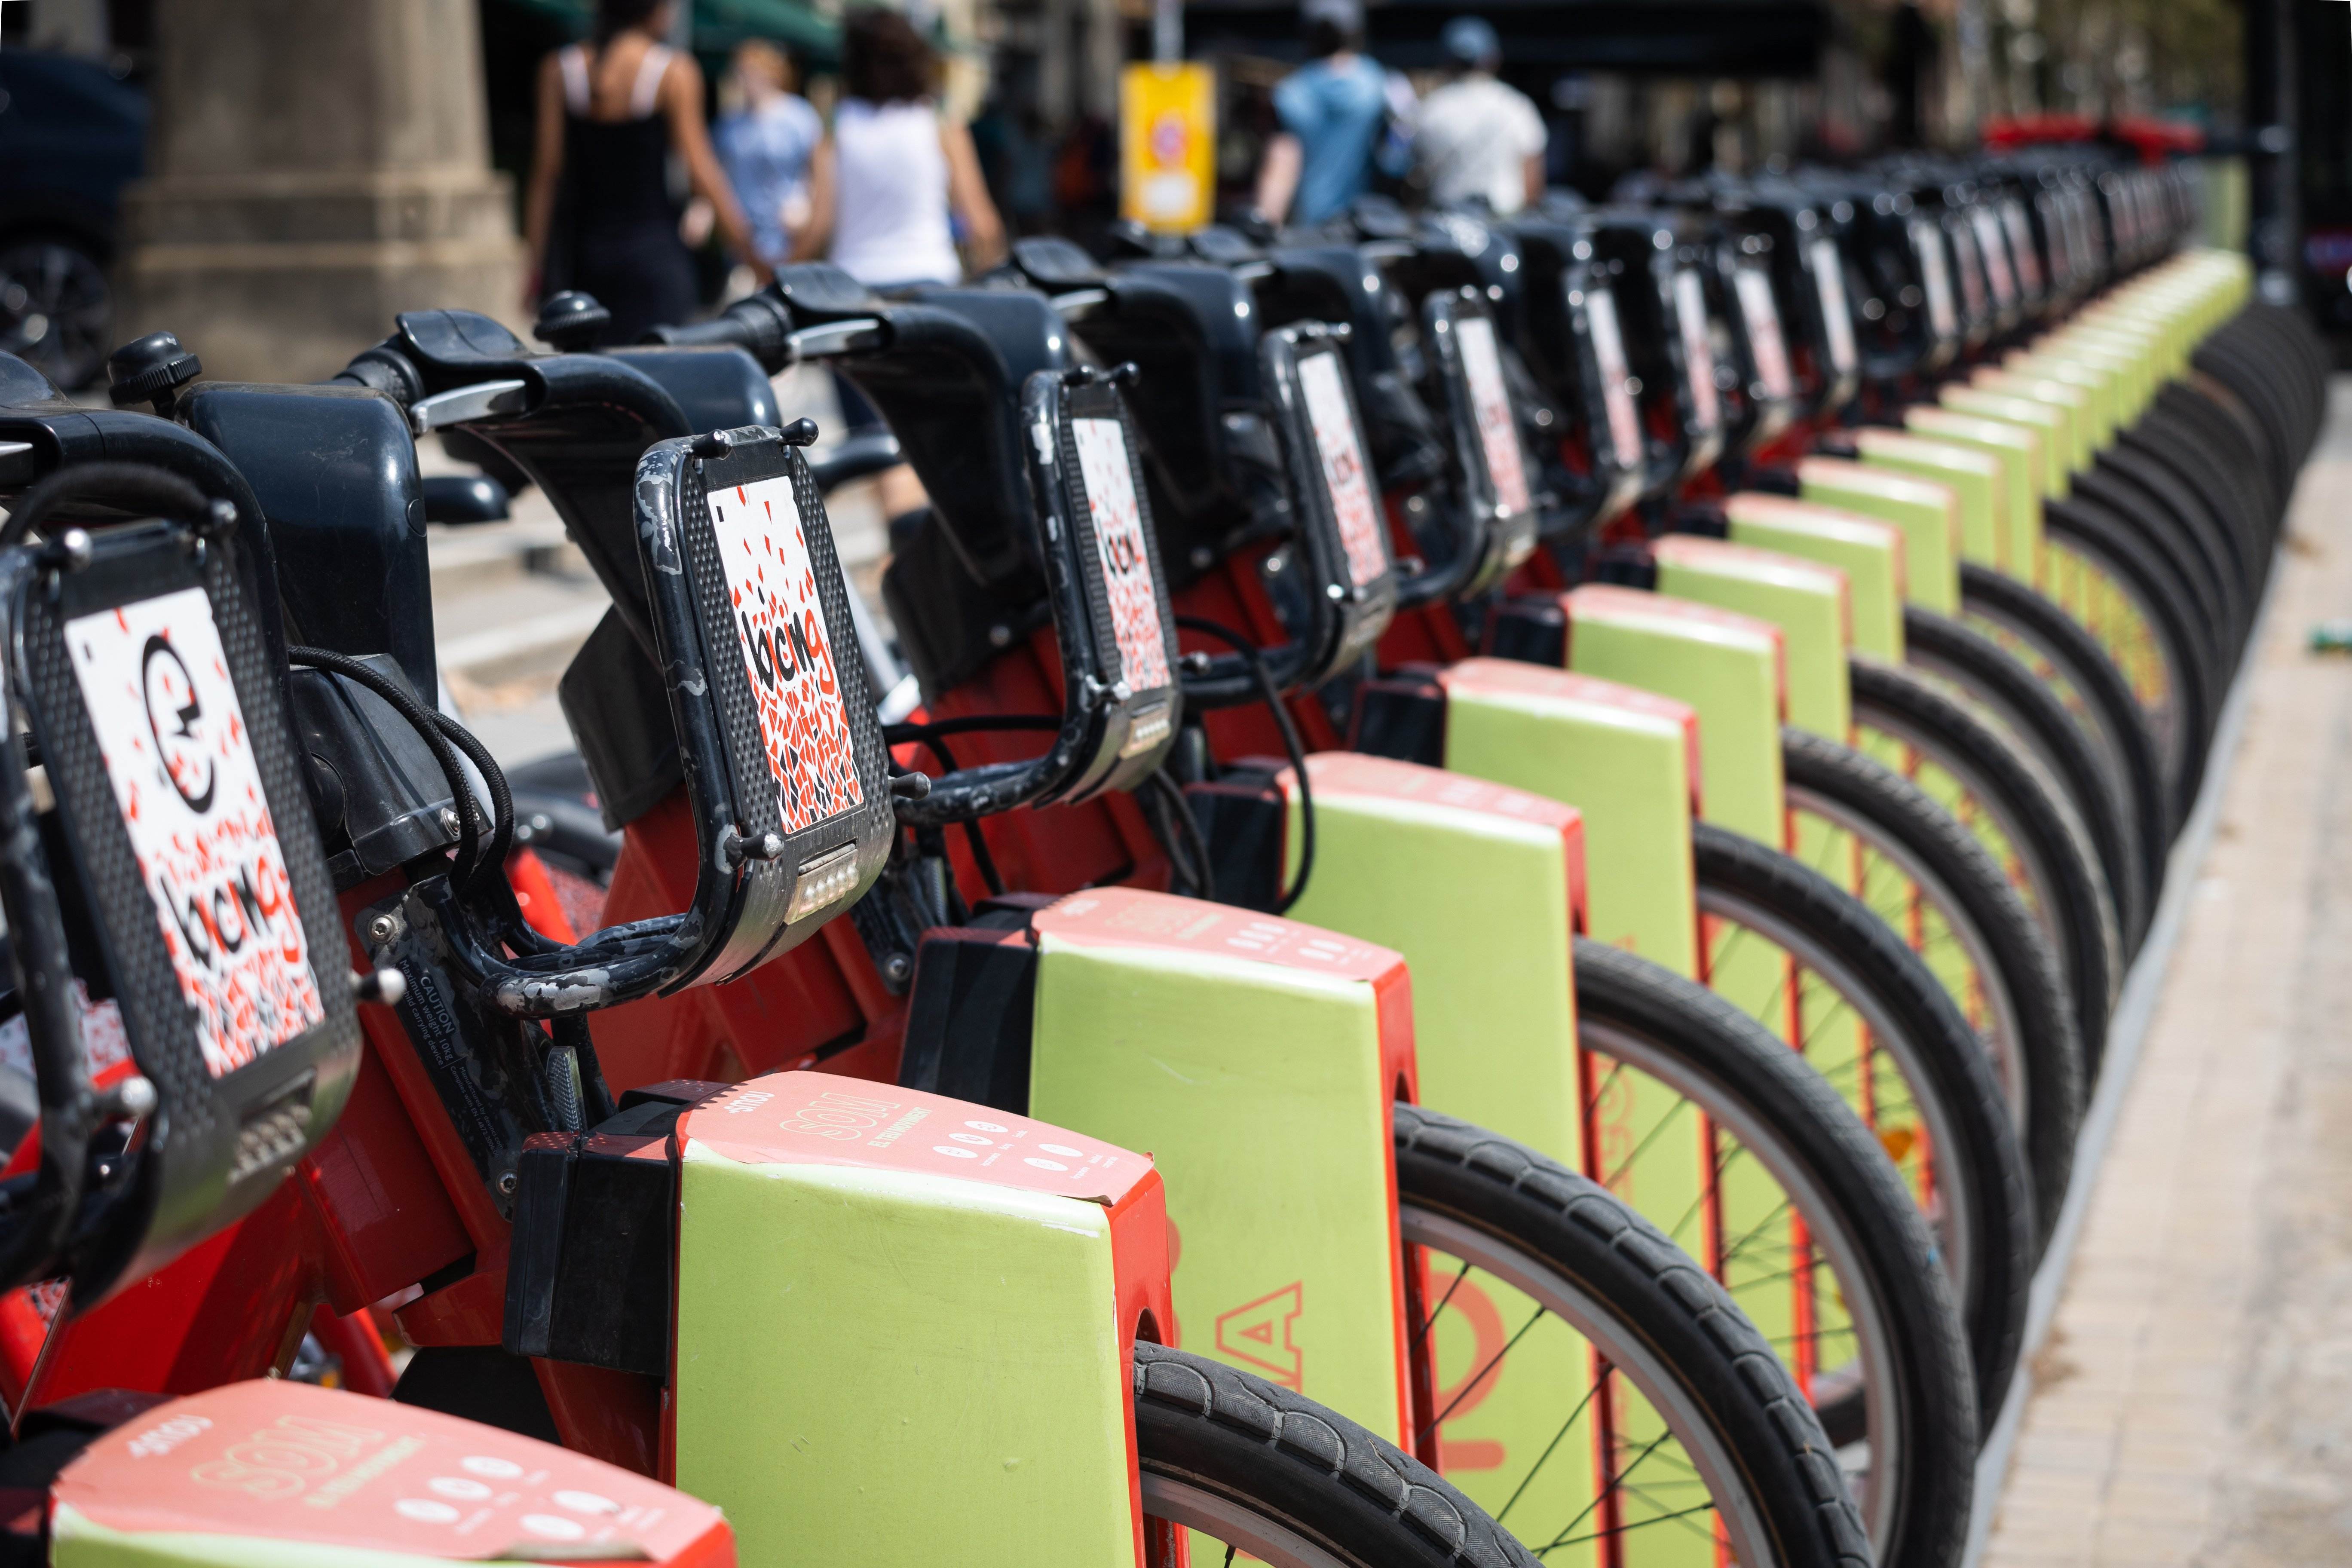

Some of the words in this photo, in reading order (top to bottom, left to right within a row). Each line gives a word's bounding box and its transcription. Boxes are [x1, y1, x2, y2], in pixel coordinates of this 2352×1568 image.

[741, 607, 835, 696] bicing
[160, 855, 300, 968] bicing
[399, 959, 425, 1004] Maximum
[422, 1004, 443, 1037] weight
[439, 1038, 454, 1061] 10kg
[420, 976, 455, 1034] CAUTION
[412, 1008, 431, 1040] carrying
[428, 1037, 444, 1066] device
[450, 1066, 466, 1093] Complies
[464, 1093, 473, 1108] with
[471, 1108, 479, 1117] EN
[459, 1066, 483, 1107] Manufactured
[480, 1106, 486, 1115] by
[484, 1115, 503, 1150] devinci.com
[724, 1090, 775, 1114] smou
[779, 1092, 901, 1141] SOM
[887, 1107, 933, 1133] MOVIMENT
[874, 1130, 902, 1141] TEU
[190, 1415, 386, 1500] SOM
